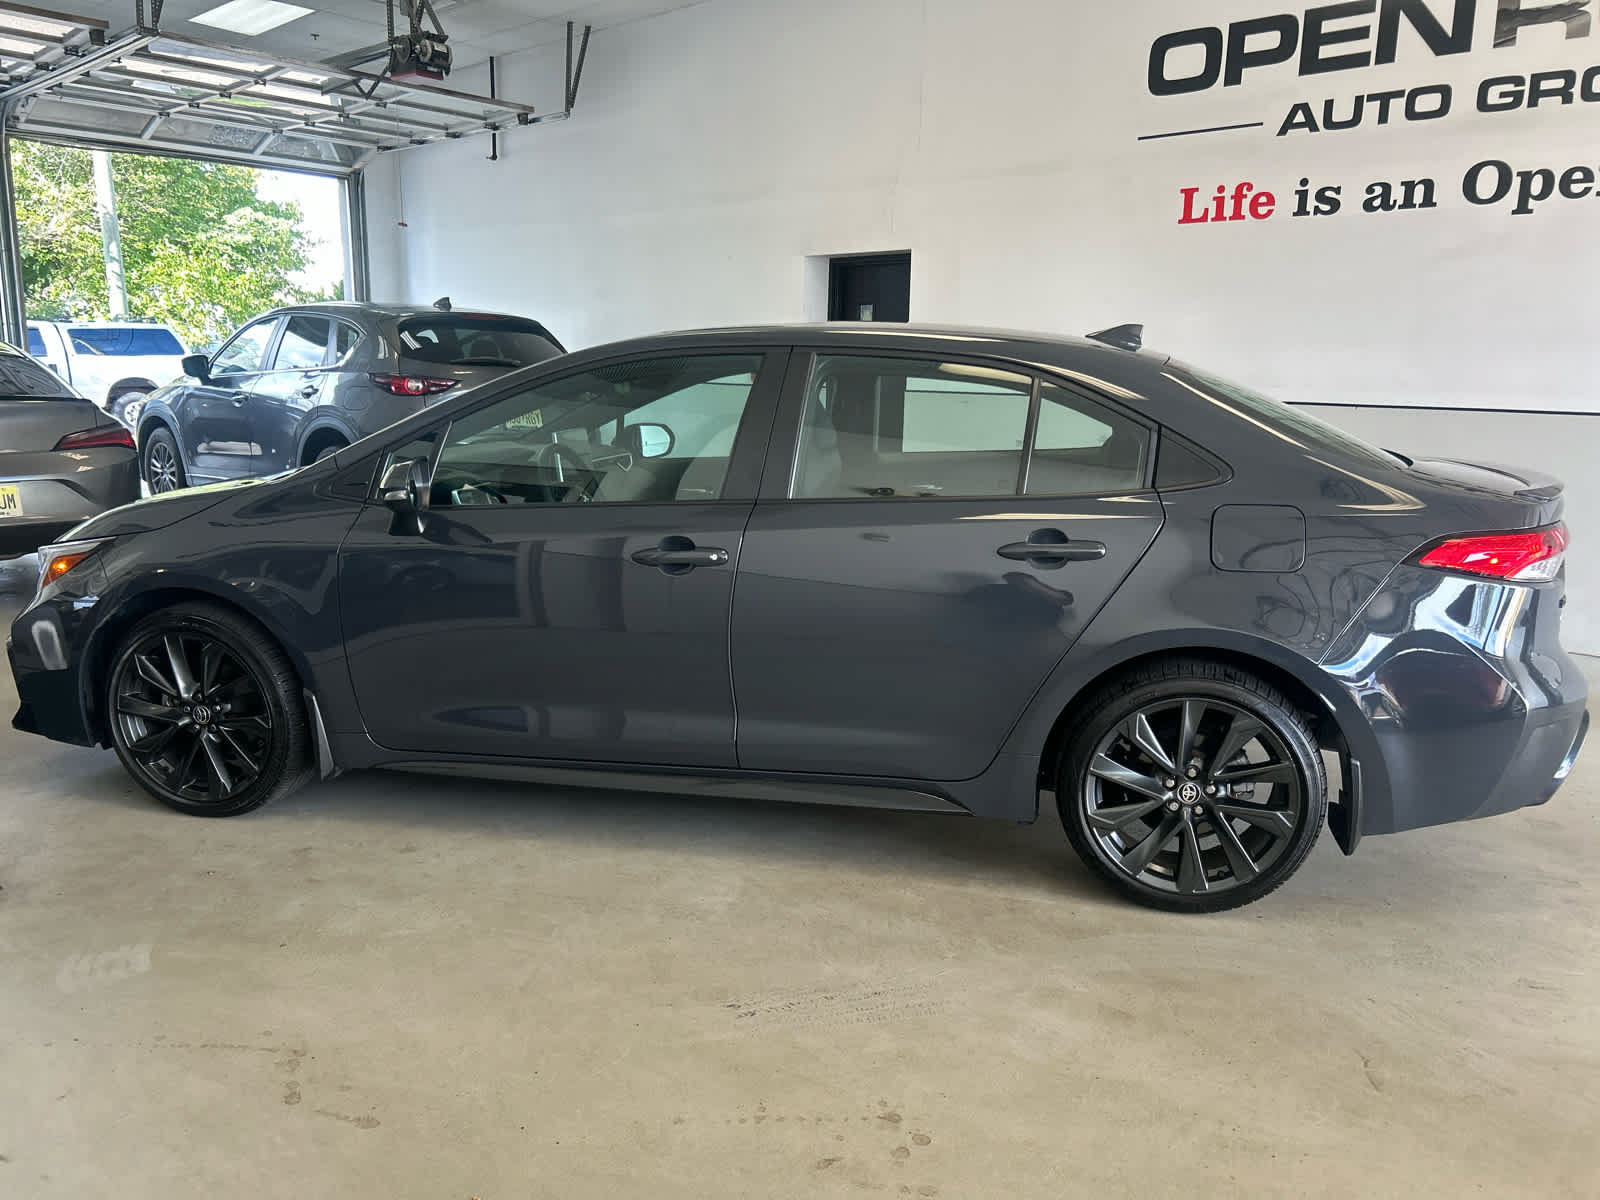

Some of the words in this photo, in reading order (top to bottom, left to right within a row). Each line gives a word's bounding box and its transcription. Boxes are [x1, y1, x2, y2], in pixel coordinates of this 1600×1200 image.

[1148, 0, 1477, 96] OPEN
[1493, 0, 1600, 49] R
[1276, 84, 1453, 137] AUTO
[1177, 182, 1276, 225] Life
[1292, 178, 1342, 217] is
[1362, 178, 1437, 211] an
[1462, 160, 1600, 216] Ope
